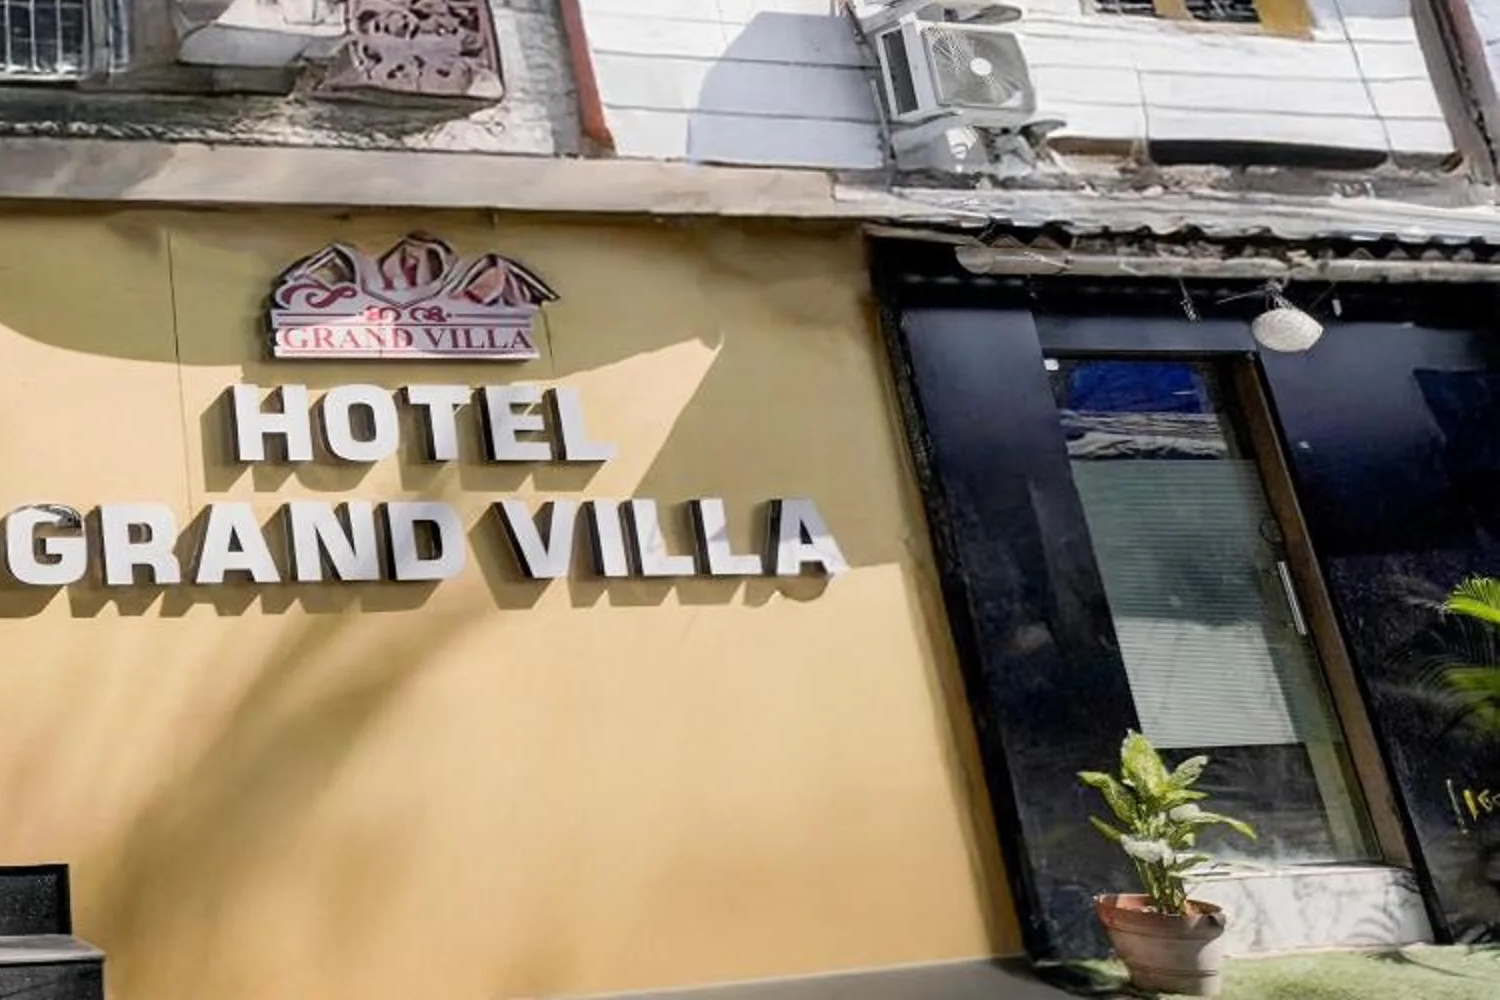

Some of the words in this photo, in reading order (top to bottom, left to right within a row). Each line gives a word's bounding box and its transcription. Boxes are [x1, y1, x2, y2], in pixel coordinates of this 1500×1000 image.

[282, 326, 414, 350] GRAND
[424, 326, 533, 350] VILLA
[233, 384, 618, 463] HOTEL
[2, 500, 468, 586] GRAND
[500, 498, 850, 580] VILLA
